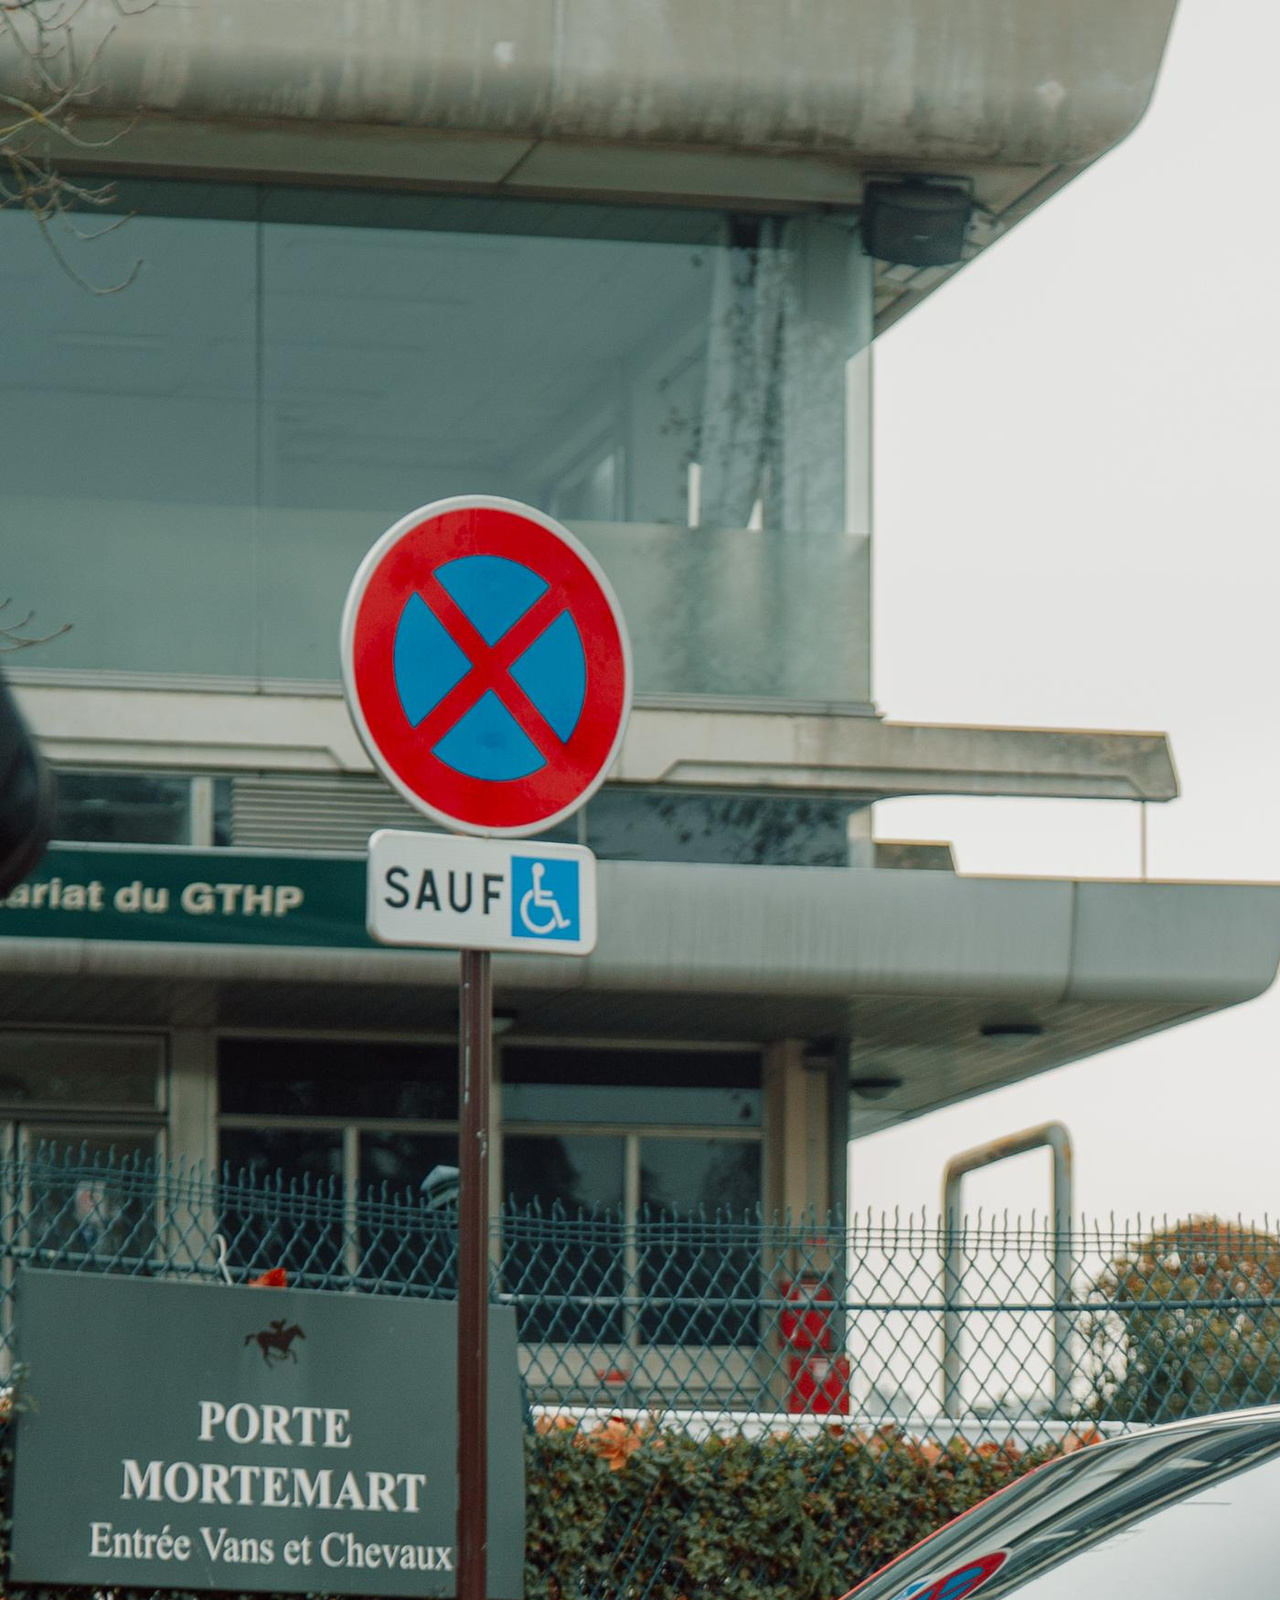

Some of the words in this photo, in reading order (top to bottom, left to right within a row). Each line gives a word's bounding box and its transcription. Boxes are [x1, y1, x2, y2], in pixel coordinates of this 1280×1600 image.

[1, 877, 105, 912] ariat
[114, 879, 168, 914] du
[181, 881, 304, 917] GTHP
[384, 865, 505, 915] SAUF
[198, 1400, 352, 1448] PORTE
[120, 1458, 427, 1513] MORTEMART
[88, 1521, 191, 1562] Entrée
[199, 1526, 275, 1566] Vans
[283, 1533, 313, 1567] et
[319, 1530, 454, 1572] Chevaux
